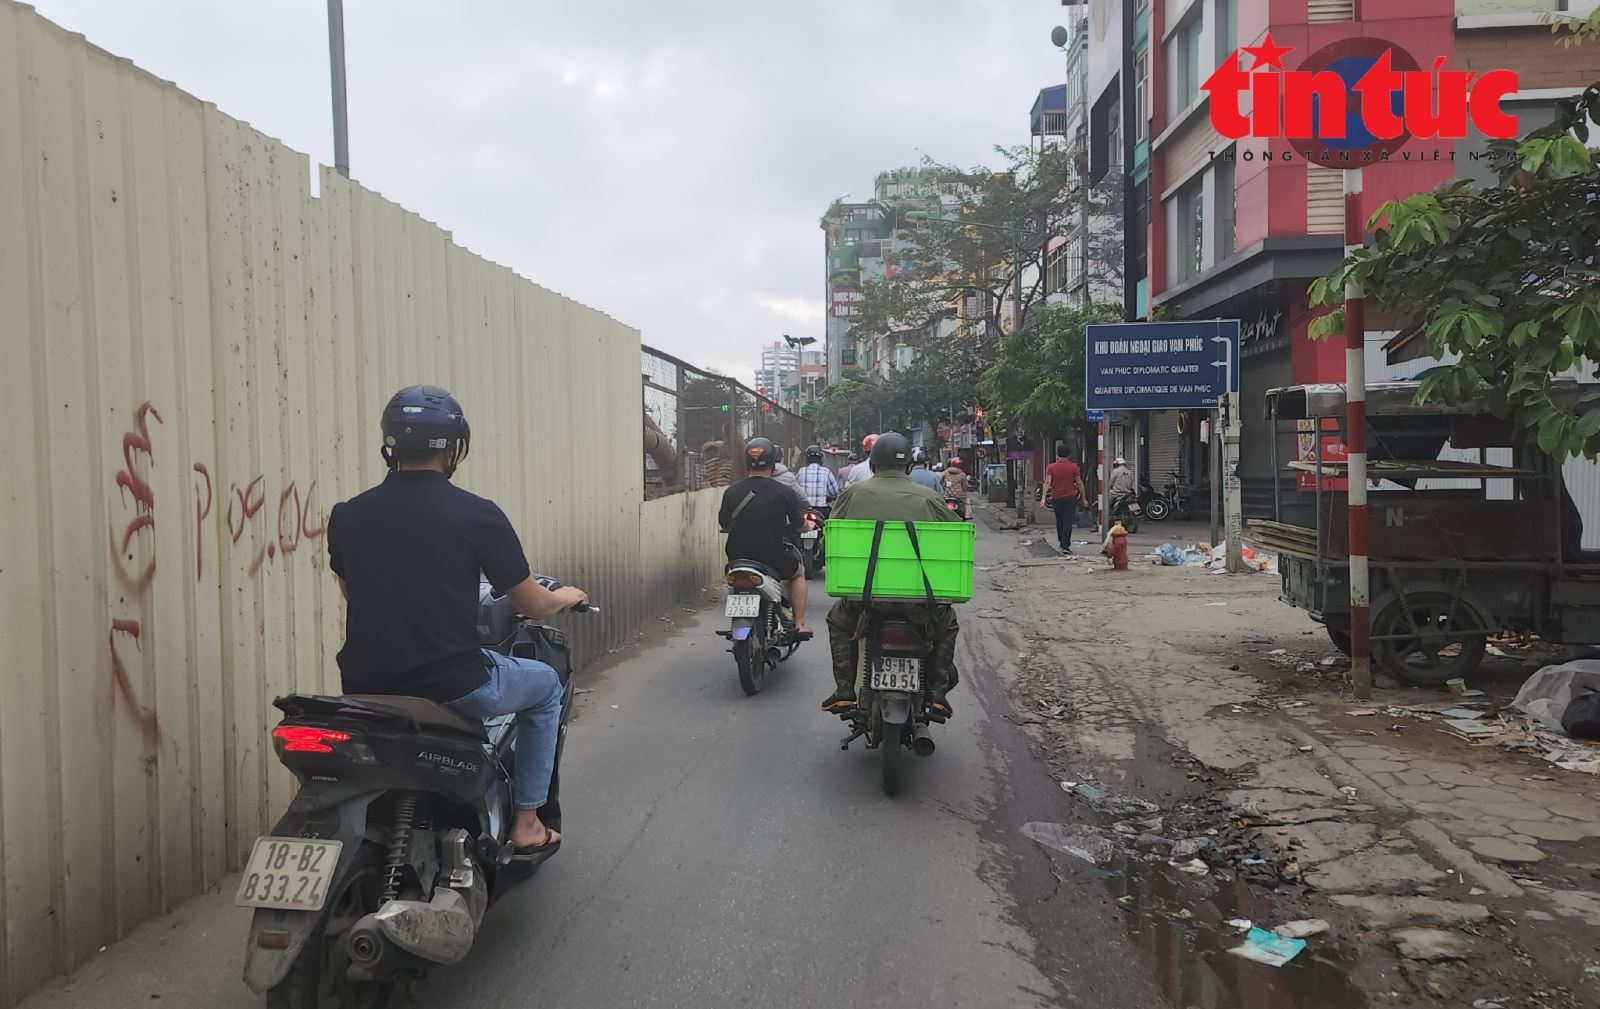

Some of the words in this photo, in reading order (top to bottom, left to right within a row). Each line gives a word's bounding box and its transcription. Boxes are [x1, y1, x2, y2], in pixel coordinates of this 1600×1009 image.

[1095, 341, 1109, 354] KHU
[1130, 340, 1151, 356] NGOẠI
[1152, 339, 1168, 352] GIAO
[1169, 338, 1184, 354] VẠN
[1185, 334, 1204, 351] PHÚC
[1100, 367, 1114, 375] VAN
[1115, 367, 1132, 375] PHUC
[1133, 365, 1169, 374] DIPLOMATIC
[1170, 364, 1199, 373] QUARTER
[1094, 386, 1123, 395] QUARTIER
[1124, 385, 1169, 394] DIPLOMATIQUE
[1169, 385, 1178, 393] DE
[1179, 385, 1193, 393] VAN
[1194, 384, 1211, 392] PHUC
[873, 673, 916, 690] 648.54
[265, 842, 327, 873] 18-B2
[244, 872, 322, 906] 833.24
